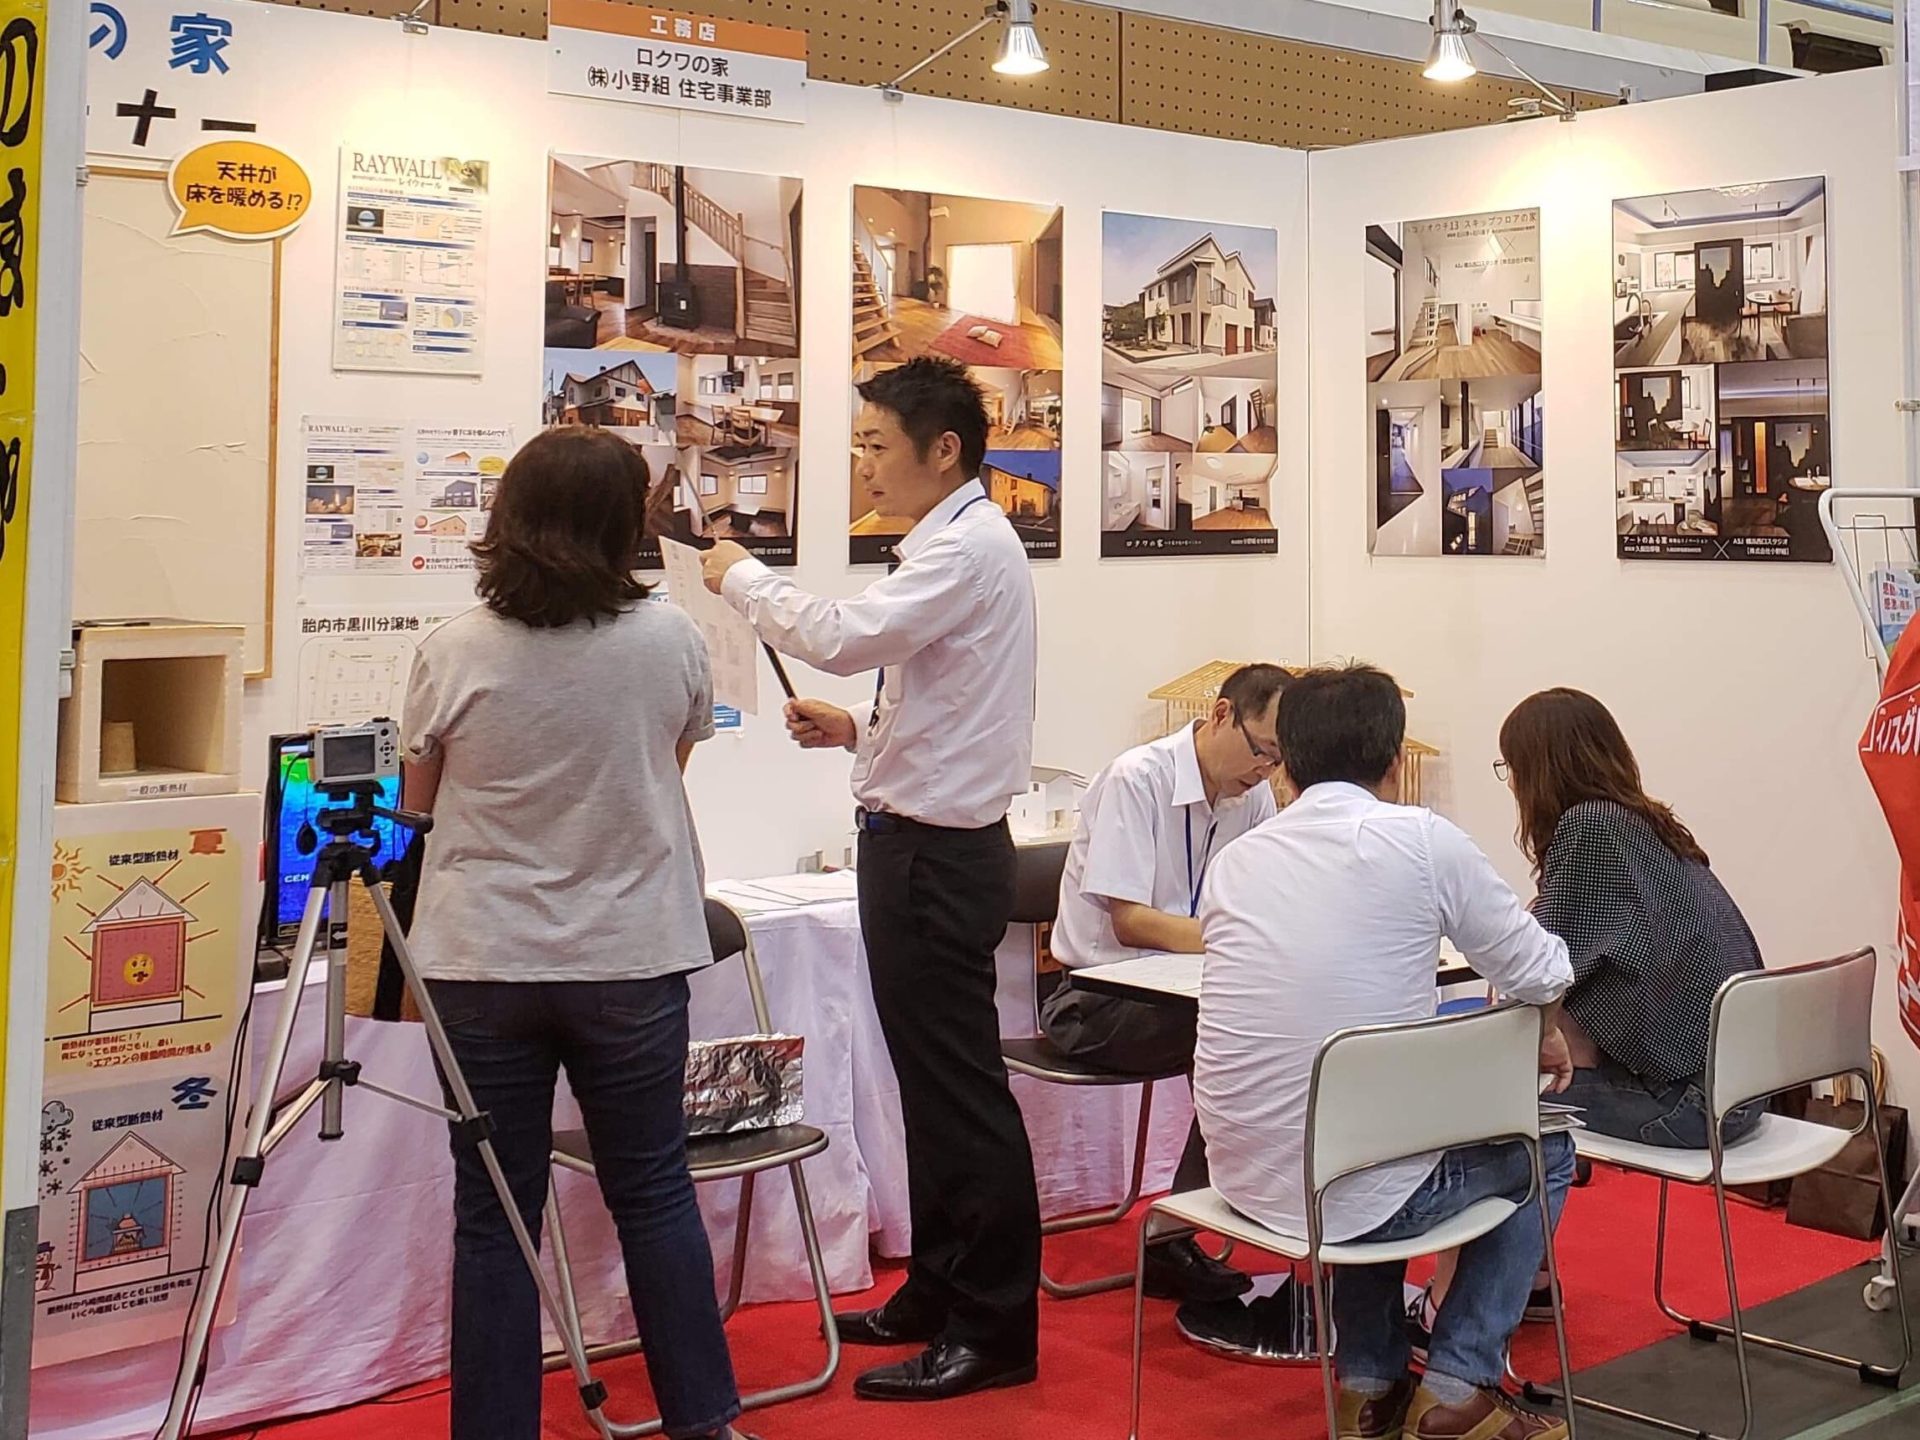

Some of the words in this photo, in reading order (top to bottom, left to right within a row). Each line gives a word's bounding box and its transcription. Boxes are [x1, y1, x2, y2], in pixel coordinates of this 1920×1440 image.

[650, 15, 717, 43] 工務店
[636, 48, 730, 78] ロクワの家
[678, 78, 772, 109] 住宅事業部
[86, 88, 257, 147] ナー
[216, 161, 277, 184] 天井が
[352, 152, 443, 180] RAYWALL
[398, 178, 443, 190] レイウォール
[301, 616, 420, 634] 胎内市黒川分譲地
[130, 783, 187, 795] 一般の断熱材
[108, 849, 179, 866] 従来型断熱材
[171, 1076, 218, 1110] 冬
[92, 1109, 163, 1132] 従来型断熱材
